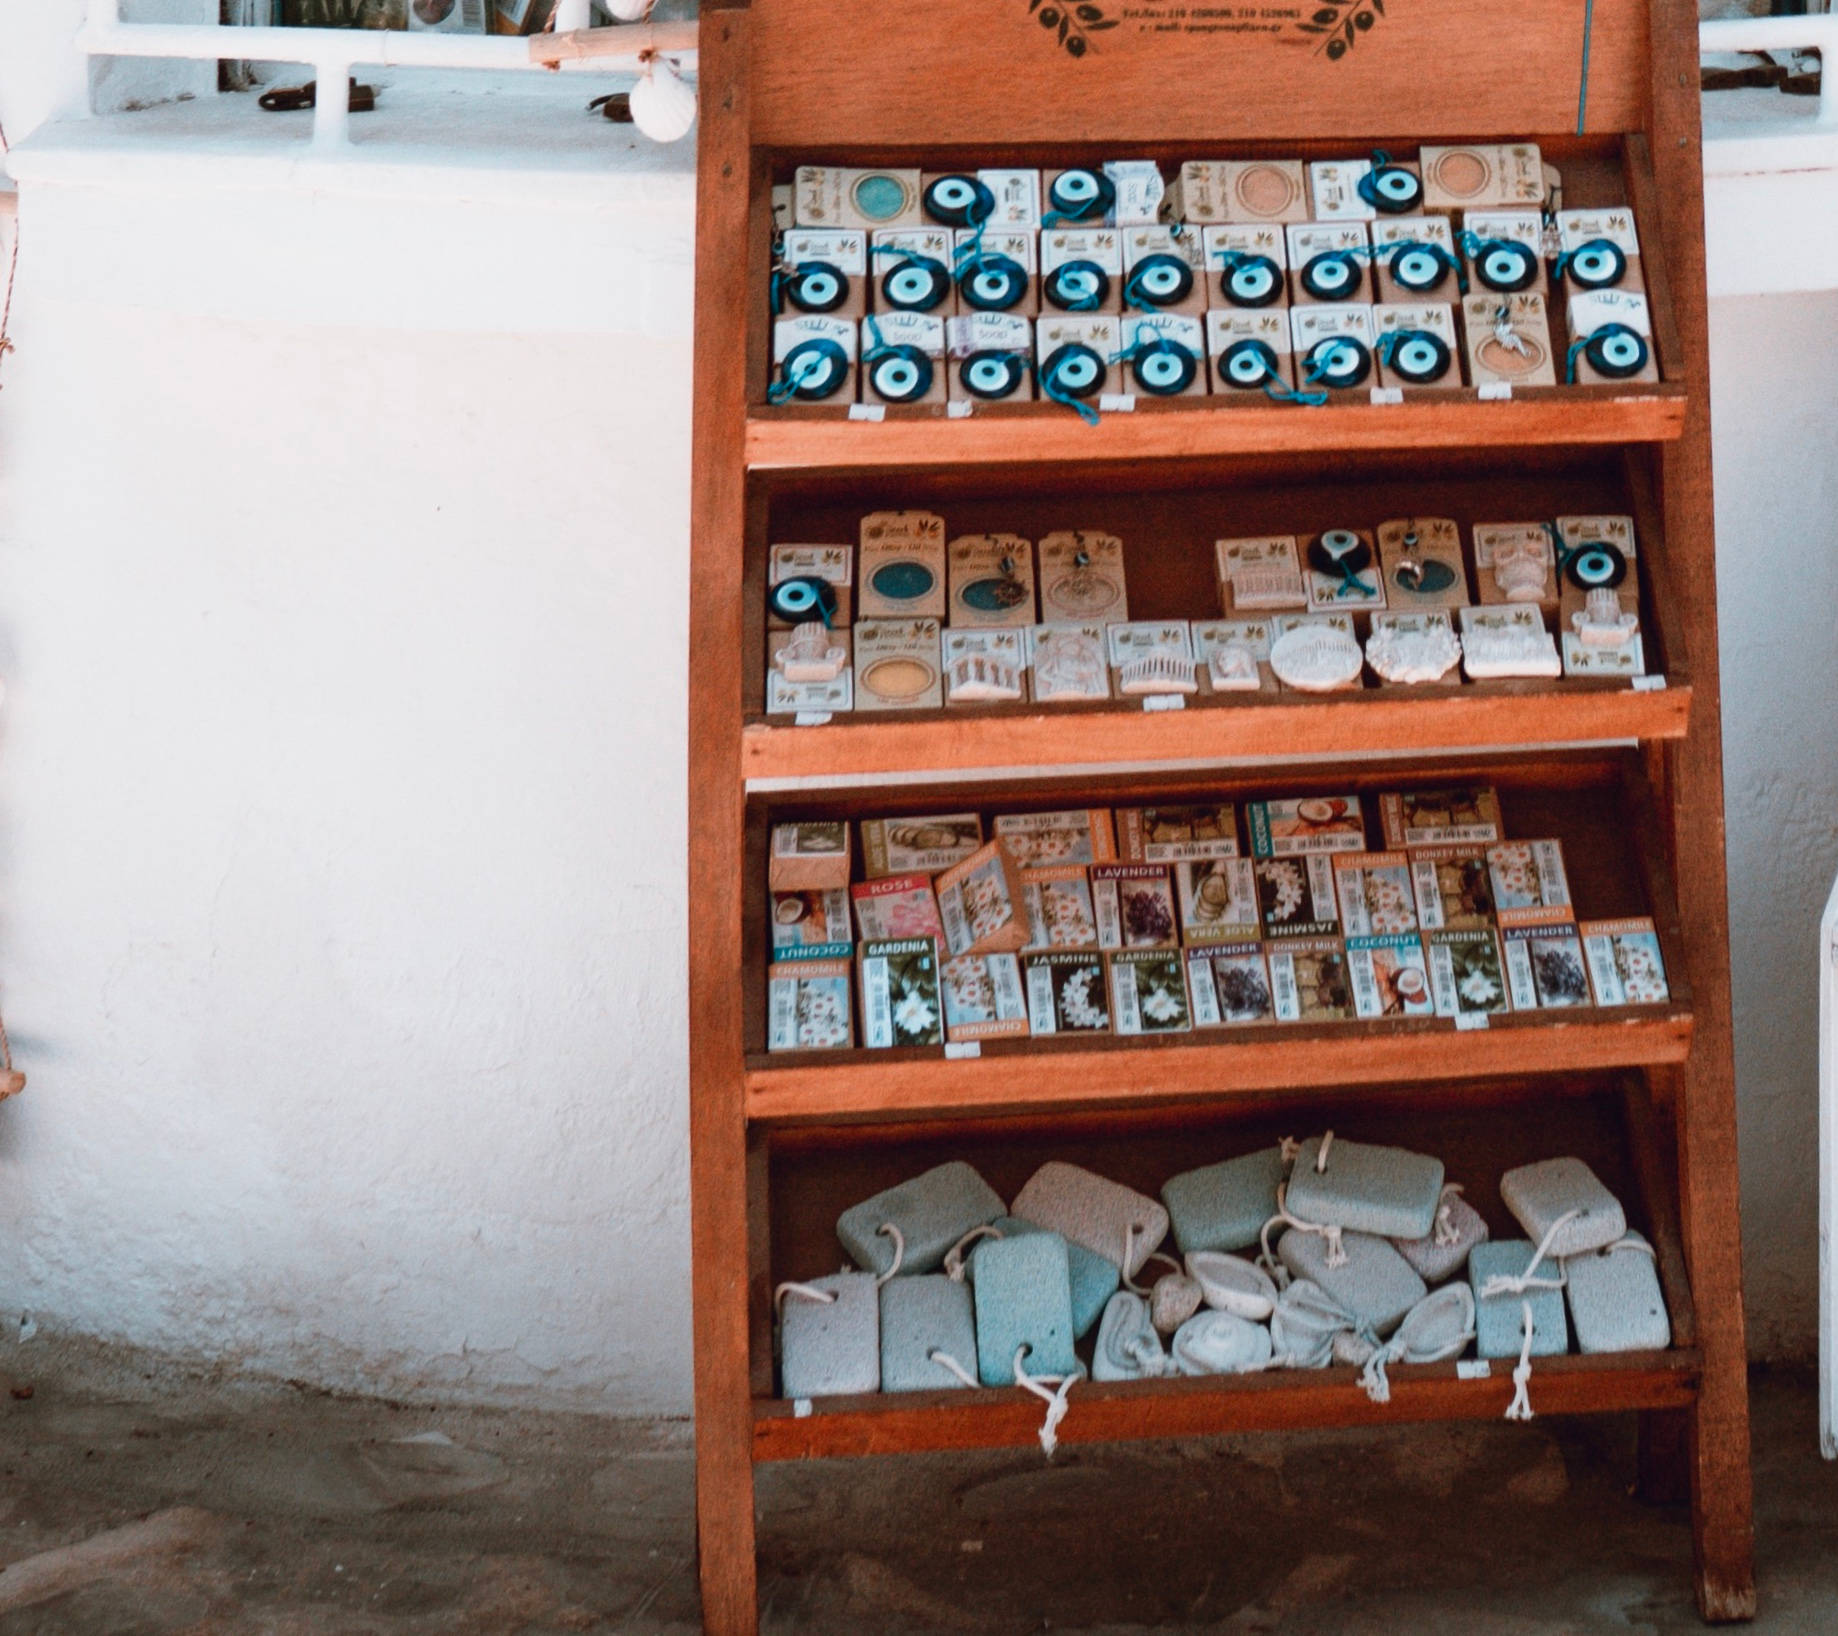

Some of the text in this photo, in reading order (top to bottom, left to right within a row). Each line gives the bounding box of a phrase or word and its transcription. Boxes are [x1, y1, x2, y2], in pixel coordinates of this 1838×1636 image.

[1097, 866, 1165, 878] LAVENDER
[871, 879, 913, 895] ROSE
[1432, 932, 1490, 943] GARDENIA
[1507, 925, 1573, 938] LAVENDER
[868, 940, 930, 955] GARDENIA
[1350, 934, 1419, 948] COCONUT
[780, 944, 849, 960] COCONUT
[1116, 951, 1175, 962] GARDENIA
[1189, 944, 1258, 958] LAVENDER
[1032, 953, 1099, 965] JASMINE
